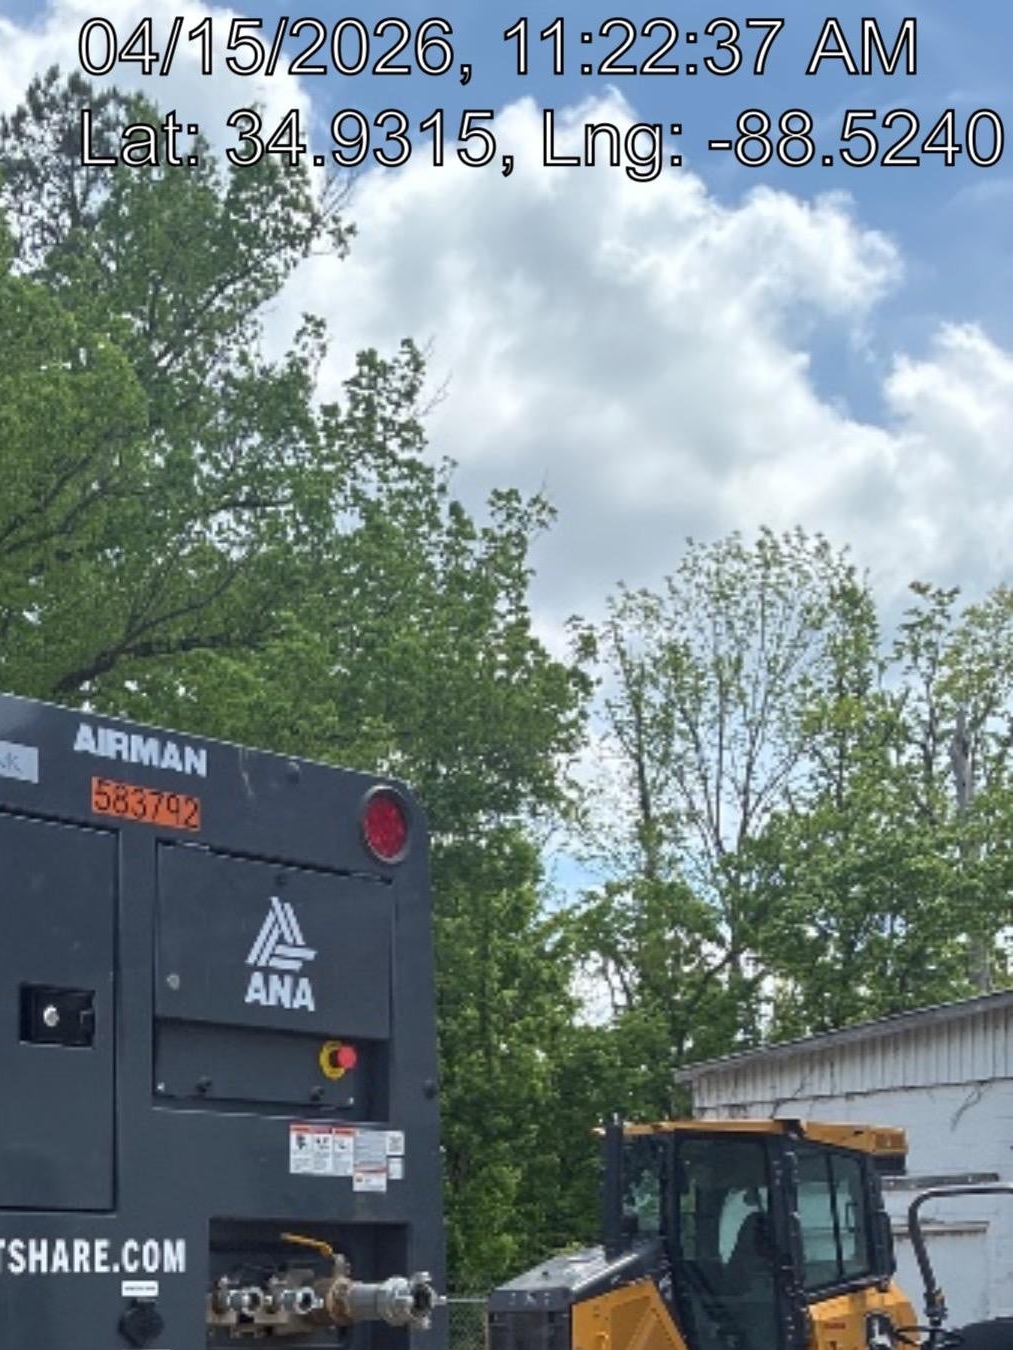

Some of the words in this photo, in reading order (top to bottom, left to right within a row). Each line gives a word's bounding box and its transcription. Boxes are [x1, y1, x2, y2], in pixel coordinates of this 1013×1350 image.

[73, 722, 207, 778] AIRMAN
[95, 779, 198, 829] 583792
[244, 971, 316, 1012] ANA
